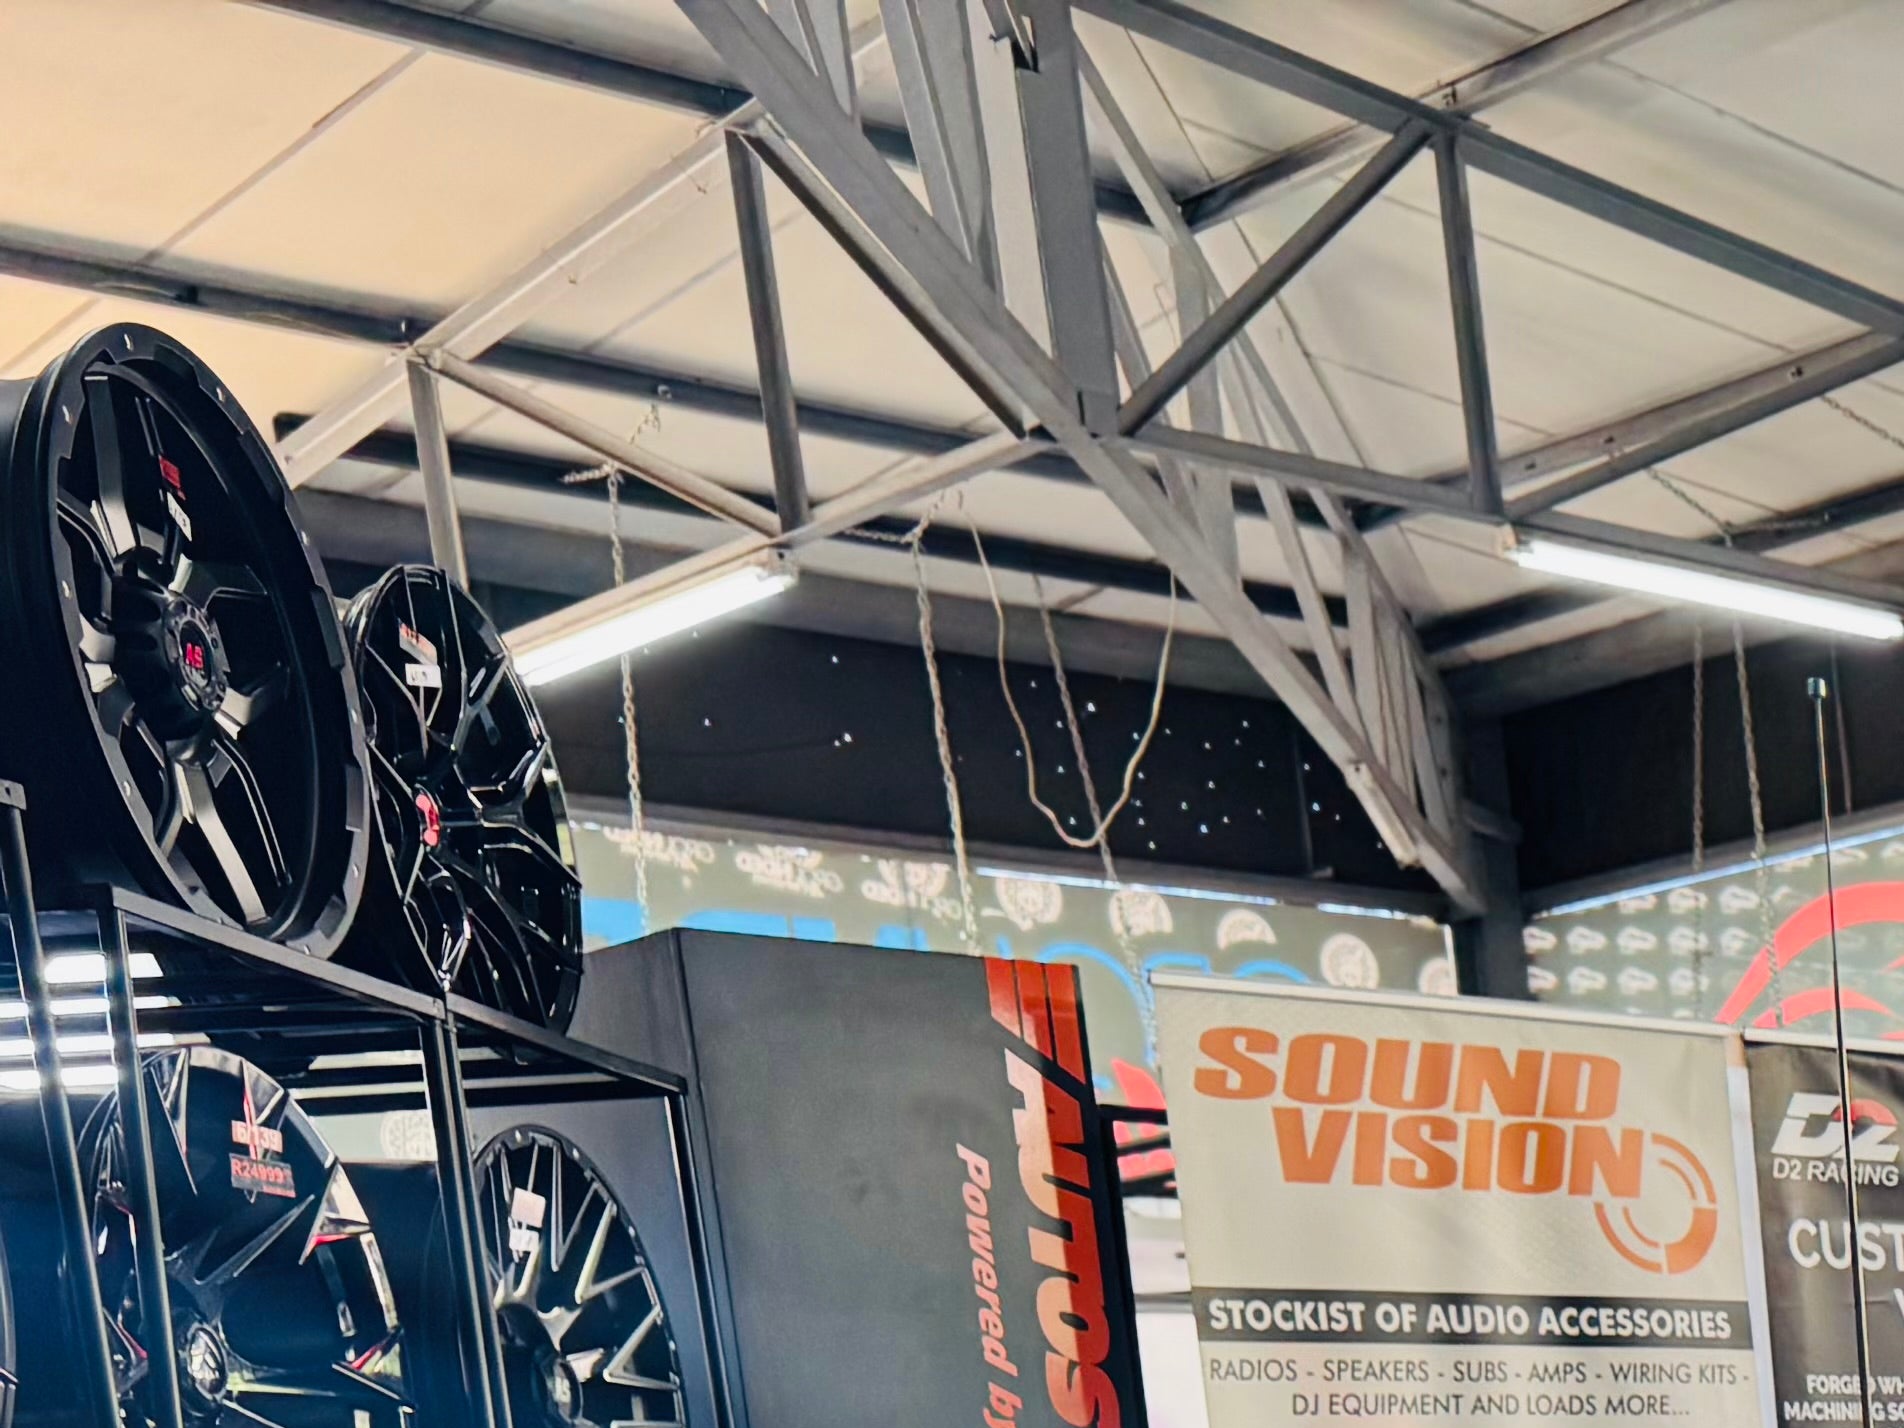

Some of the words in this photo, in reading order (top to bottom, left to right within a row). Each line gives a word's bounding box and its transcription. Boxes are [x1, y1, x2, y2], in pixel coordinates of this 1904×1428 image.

[1194, 1026, 1621, 1120] SOUND
[1272, 1106, 1645, 1198] VISION
[1773, 1159, 1802, 1181] D2
[954, 1142, 1019, 1381] Powered
[1209, 1299, 1366, 1334] STOCKIST
[1375, 1301, 1418, 1334] OF
[1427, 1302, 1527, 1336] AUDIO
[1538, 1305, 1731, 1339] ACCESSORIES
[1209, 1358, 1297, 1383] RADIOS
[1323, 1358, 1429, 1383] SPEAKERS
[1453, 1359, 1507, 1383] SUBS
[1528, 1360, 1587, 1384] AMPS
[1610, 1361, 1693, 1384] WIRING
[1699, 1361, 1735, 1385] KITS
[1292, 1393, 1321, 1416] DJ
[1329, 1393, 1462, 1417] EQUIPMENT
[1470, 1393, 1520, 1416] AND
[1527, 1394, 1596, 1416] LOADS
